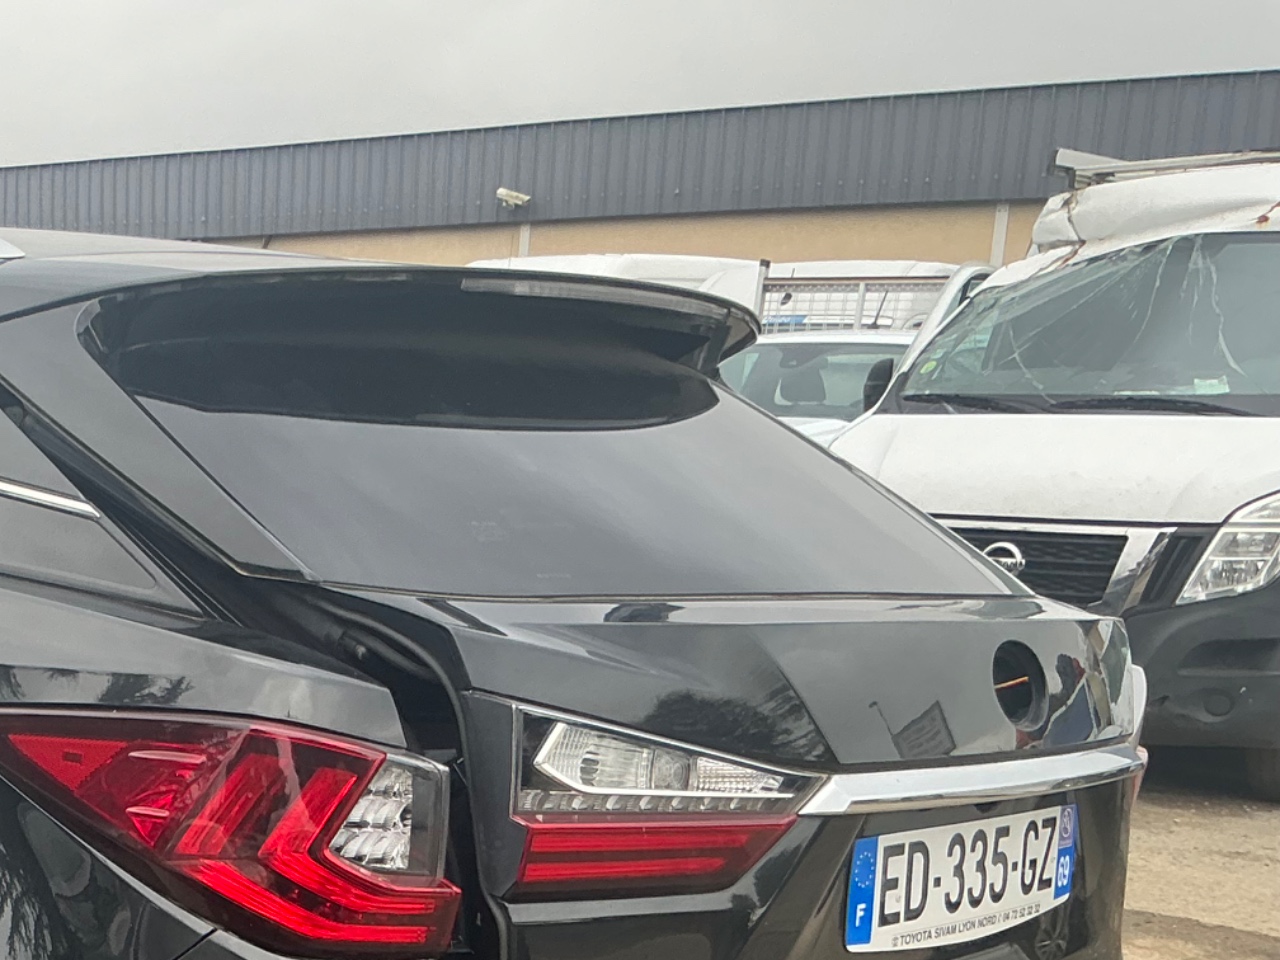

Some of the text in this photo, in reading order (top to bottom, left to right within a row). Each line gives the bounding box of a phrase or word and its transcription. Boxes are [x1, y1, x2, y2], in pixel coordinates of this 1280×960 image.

[877, 816, 1058, 928] ED-335-GZ
[1057, 854, 1070, 888] 69
[855, 902, 867, 928] F
[900, 930, 933, 947] TOYOTA
[934, 923, 958, 939] SIVAM
[958, 918, 976, 934] LYON
[977, 914, 997, 929] NORD
